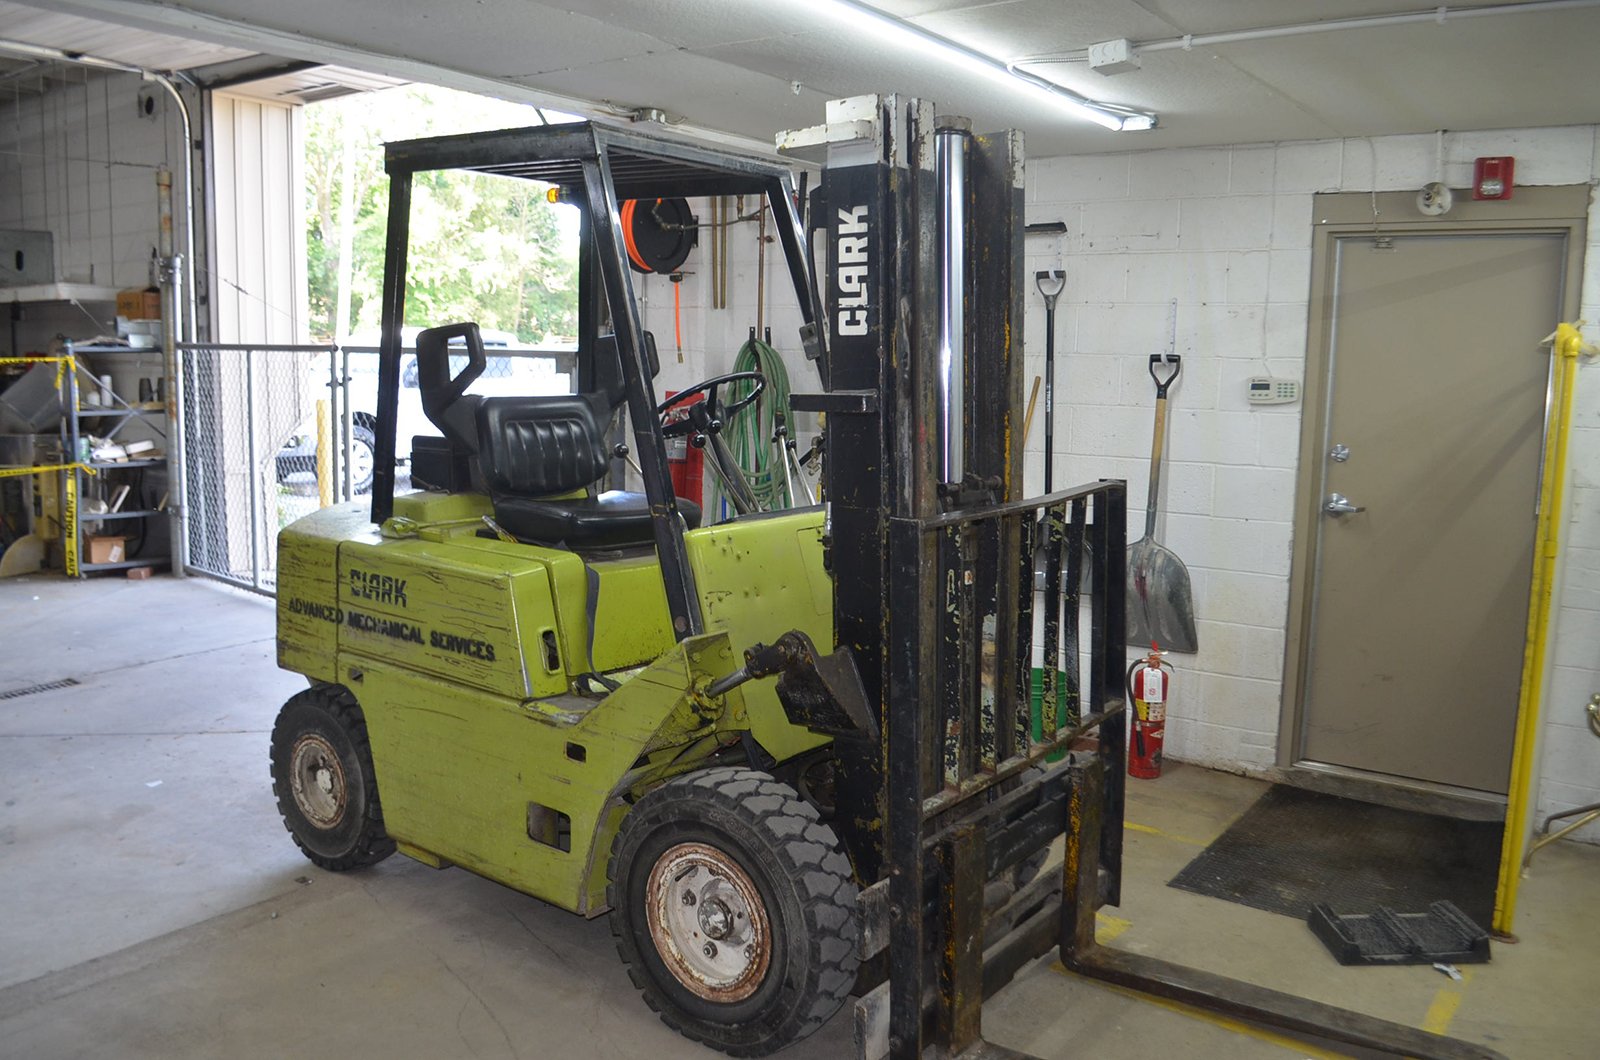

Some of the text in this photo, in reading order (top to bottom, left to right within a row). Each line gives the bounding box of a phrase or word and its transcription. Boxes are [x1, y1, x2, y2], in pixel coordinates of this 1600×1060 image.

[838, 205, 868, 336] CLARK
[66, 492, 74, 539] CAUTION
[350, 569, 407, 608] CLARK
[289, 597, 496, 662] ADVANCED MECHANICAL SERVICES
